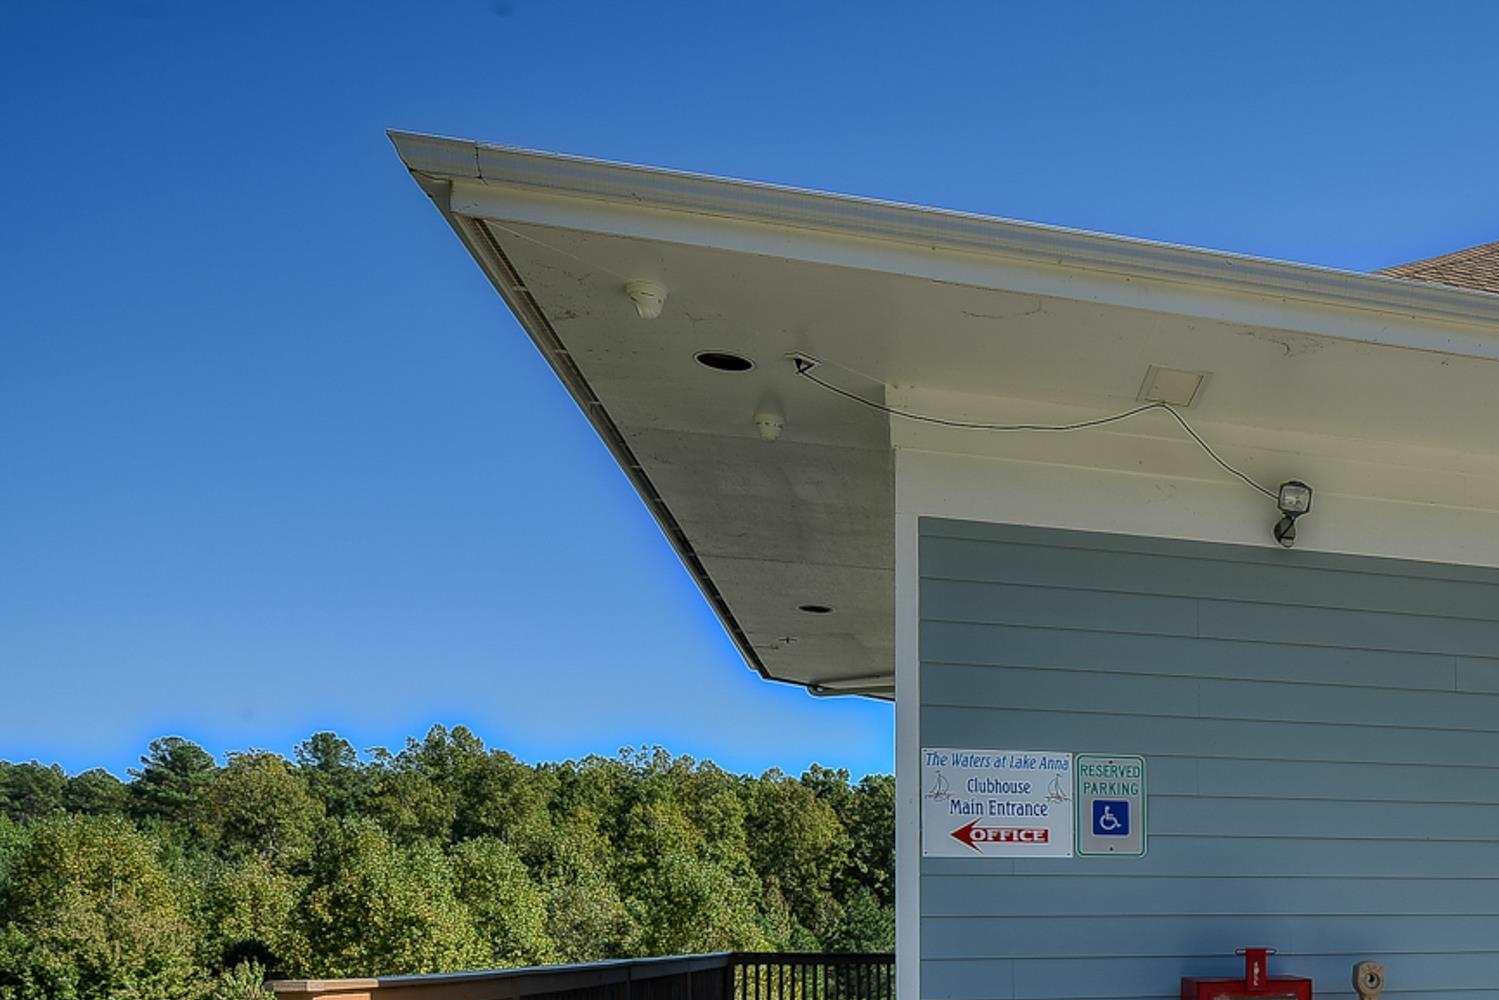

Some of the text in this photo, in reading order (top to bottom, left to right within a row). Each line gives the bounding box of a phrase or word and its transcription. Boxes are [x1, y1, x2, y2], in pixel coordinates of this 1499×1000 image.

[926, 752, 1070, 771] The Waters at Lake Anna
[1080, 765, 1140, 778] RESERVED
[967, 778, 1032, 794] Clubhouse
[1083, 782, 1138, 796] PARKING
[950, 800, 1049, 817] Main Entrance
[970, 829, 1046, 842] OFFICE
